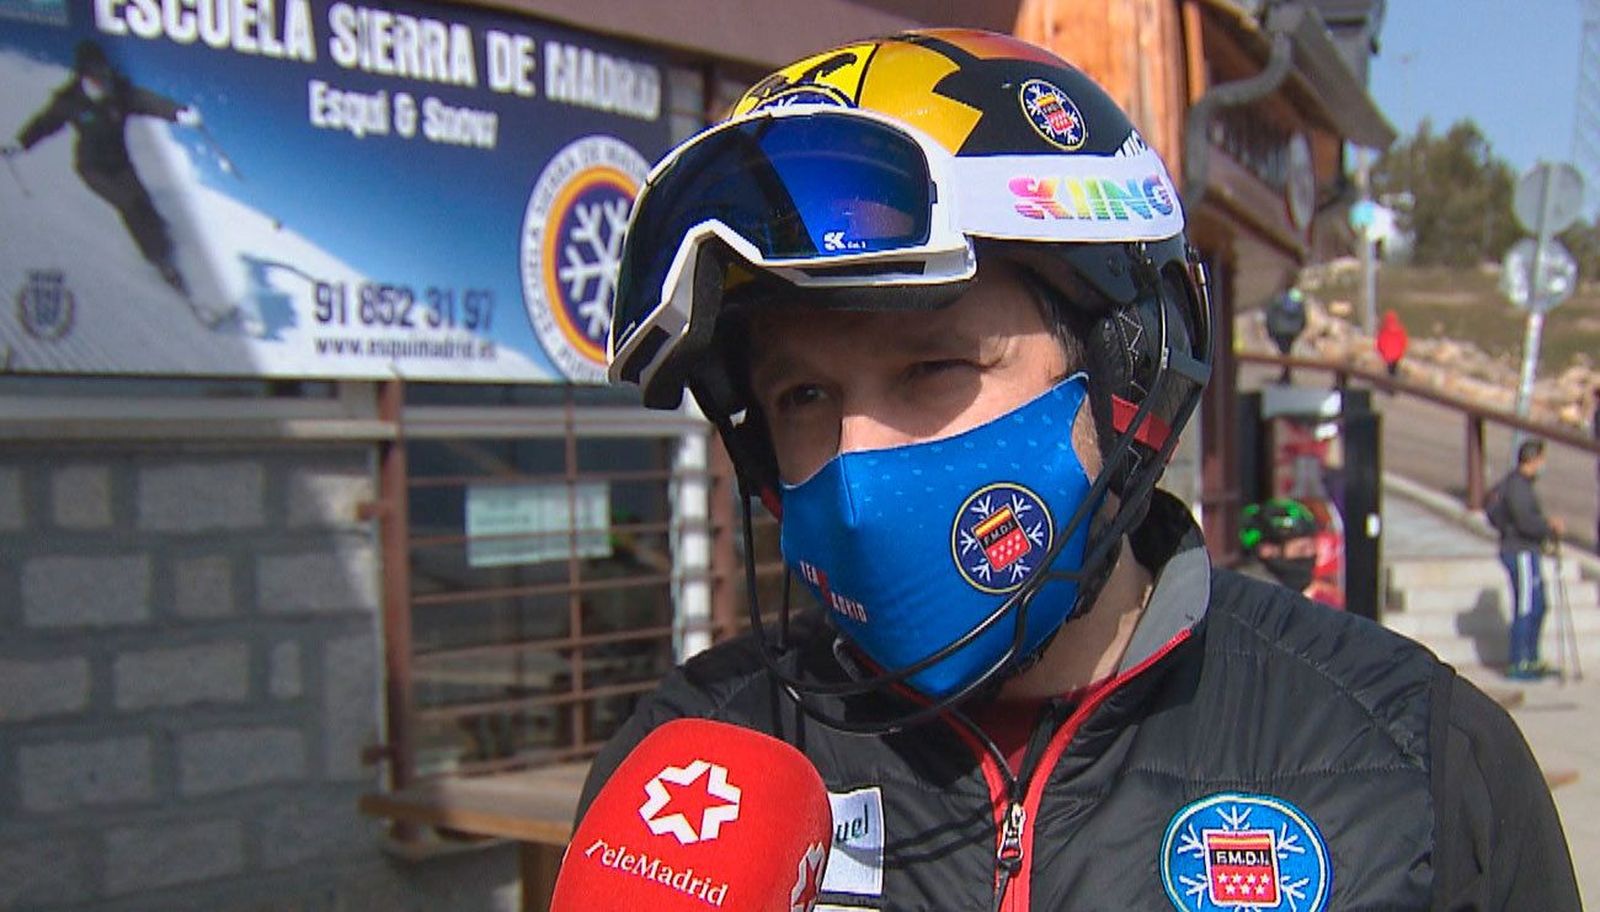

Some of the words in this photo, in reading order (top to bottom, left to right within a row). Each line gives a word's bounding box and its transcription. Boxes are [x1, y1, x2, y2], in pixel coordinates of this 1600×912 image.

[94, 0, 317, 62] ESCUELA
[328, 1, 478, 88] SIERRA
[486, 29, 537, 97] DE
[544, 40, 662, 122] MADRID
[394, 91, 417, 138] &
[422, 96, 498, 149] Snow
[1008, 174, 1174, 221] SKIING
[314, 282, 346, 325] 91
[358, 284, 415, 328] 852
[425, 286, 454, 329] 31
[464, 288, 495, 332] 97
[836, 803, 868, 841] uel
